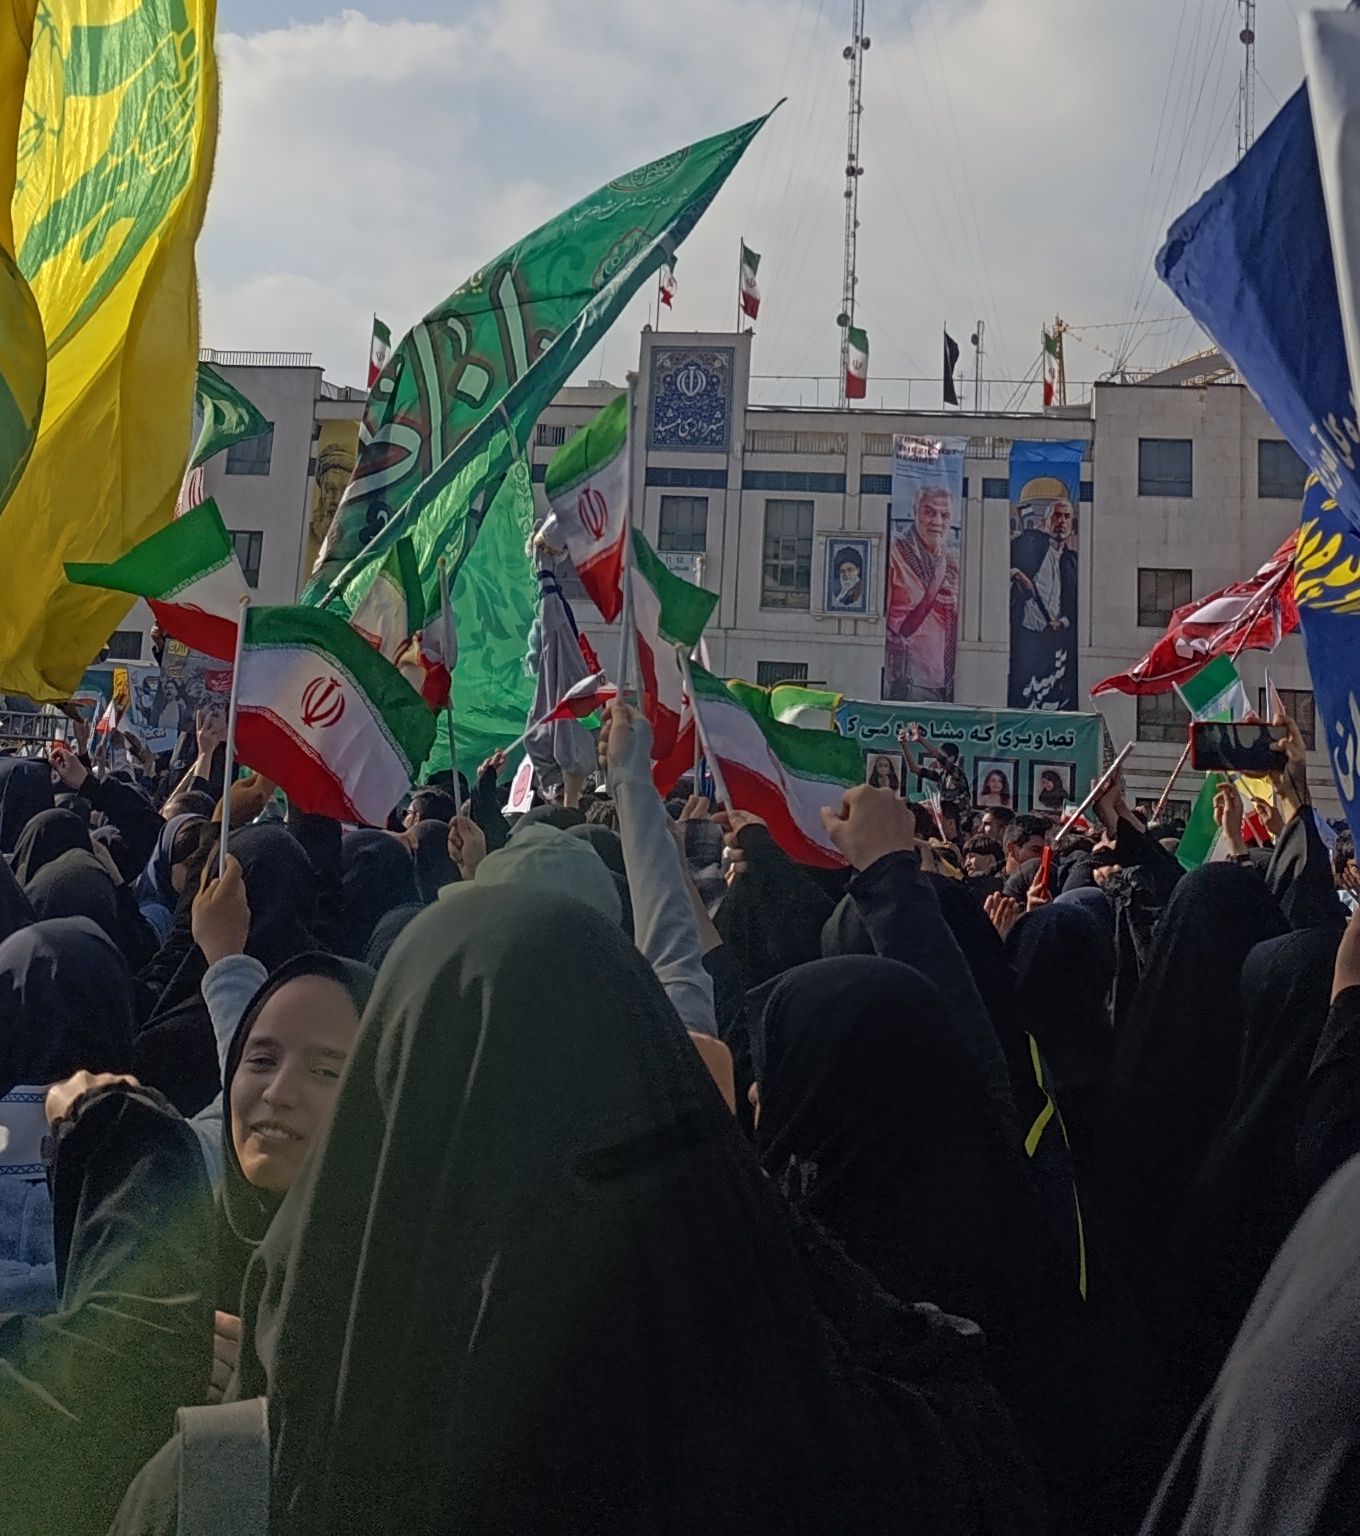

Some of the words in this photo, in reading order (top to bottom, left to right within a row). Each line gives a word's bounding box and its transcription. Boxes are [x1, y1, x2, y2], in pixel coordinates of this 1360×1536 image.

[860, 723, 891, 740] می
[895, 720, 965, 742] مشاهه
[968, 725, 995, 743] که
[996, 728, 1076, 751] تصاویری
